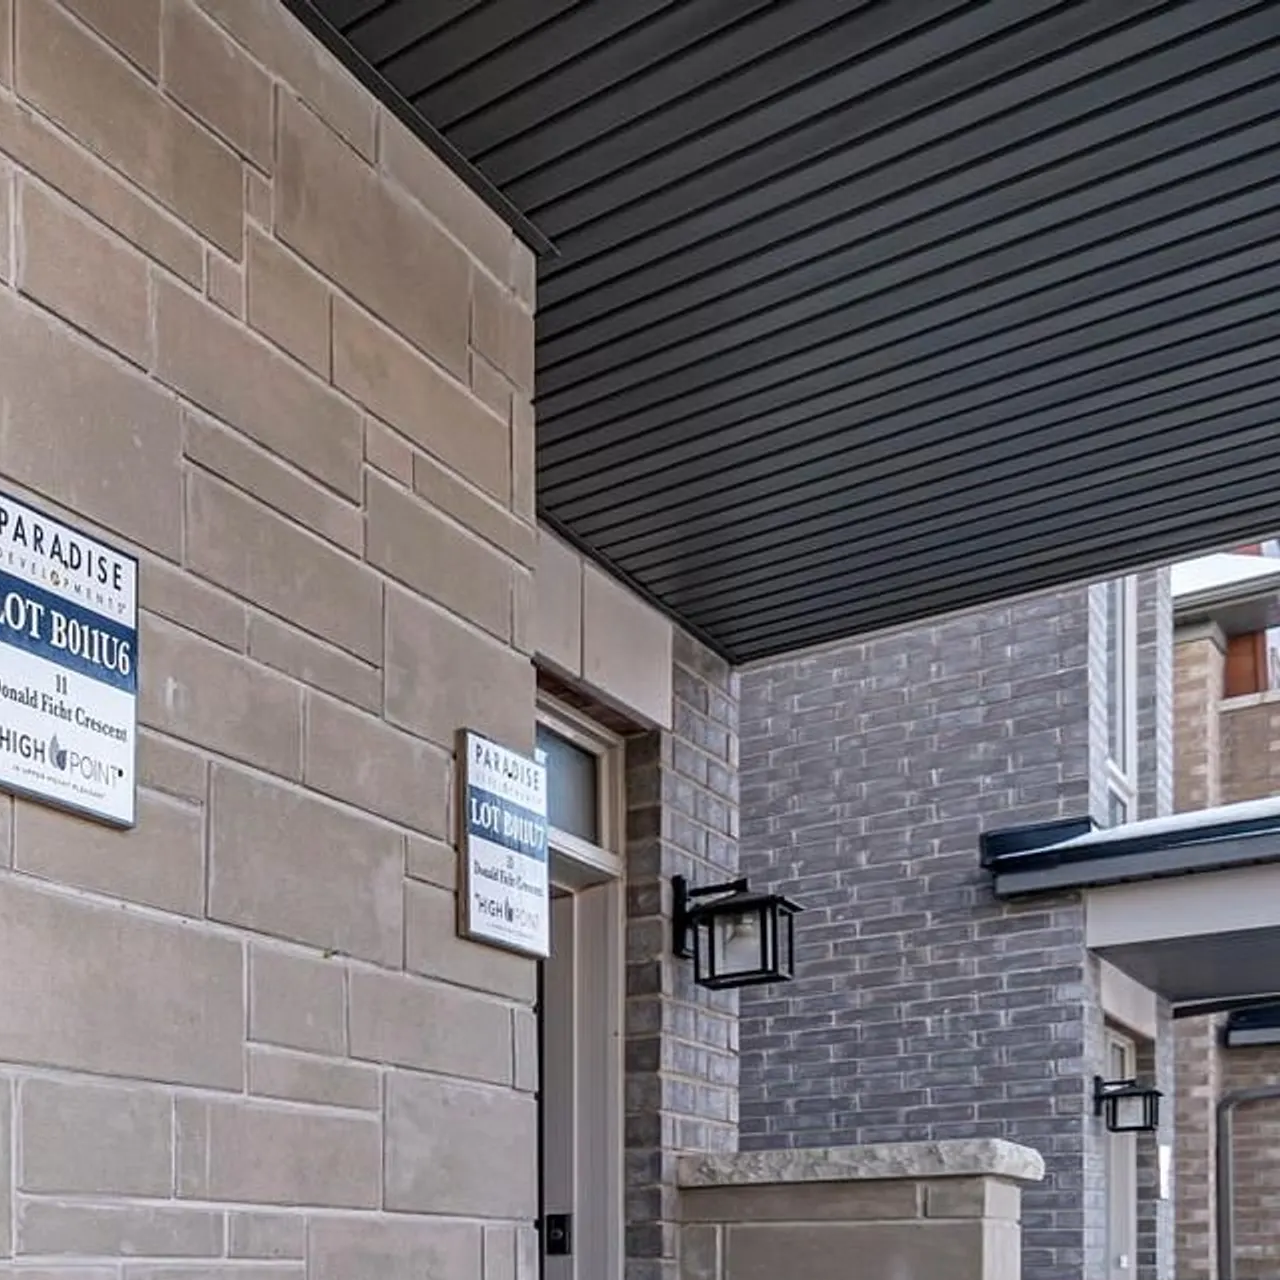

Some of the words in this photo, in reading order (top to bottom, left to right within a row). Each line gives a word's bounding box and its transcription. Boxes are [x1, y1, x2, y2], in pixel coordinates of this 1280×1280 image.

[50, 613, 131, 676] B011U6
[74, 706, 128, 743] Crescent
[69, 750, 119, 789] POINT
[475, 743, 539, 792] PARADISE
[471, 797, 501, 835] LOT
